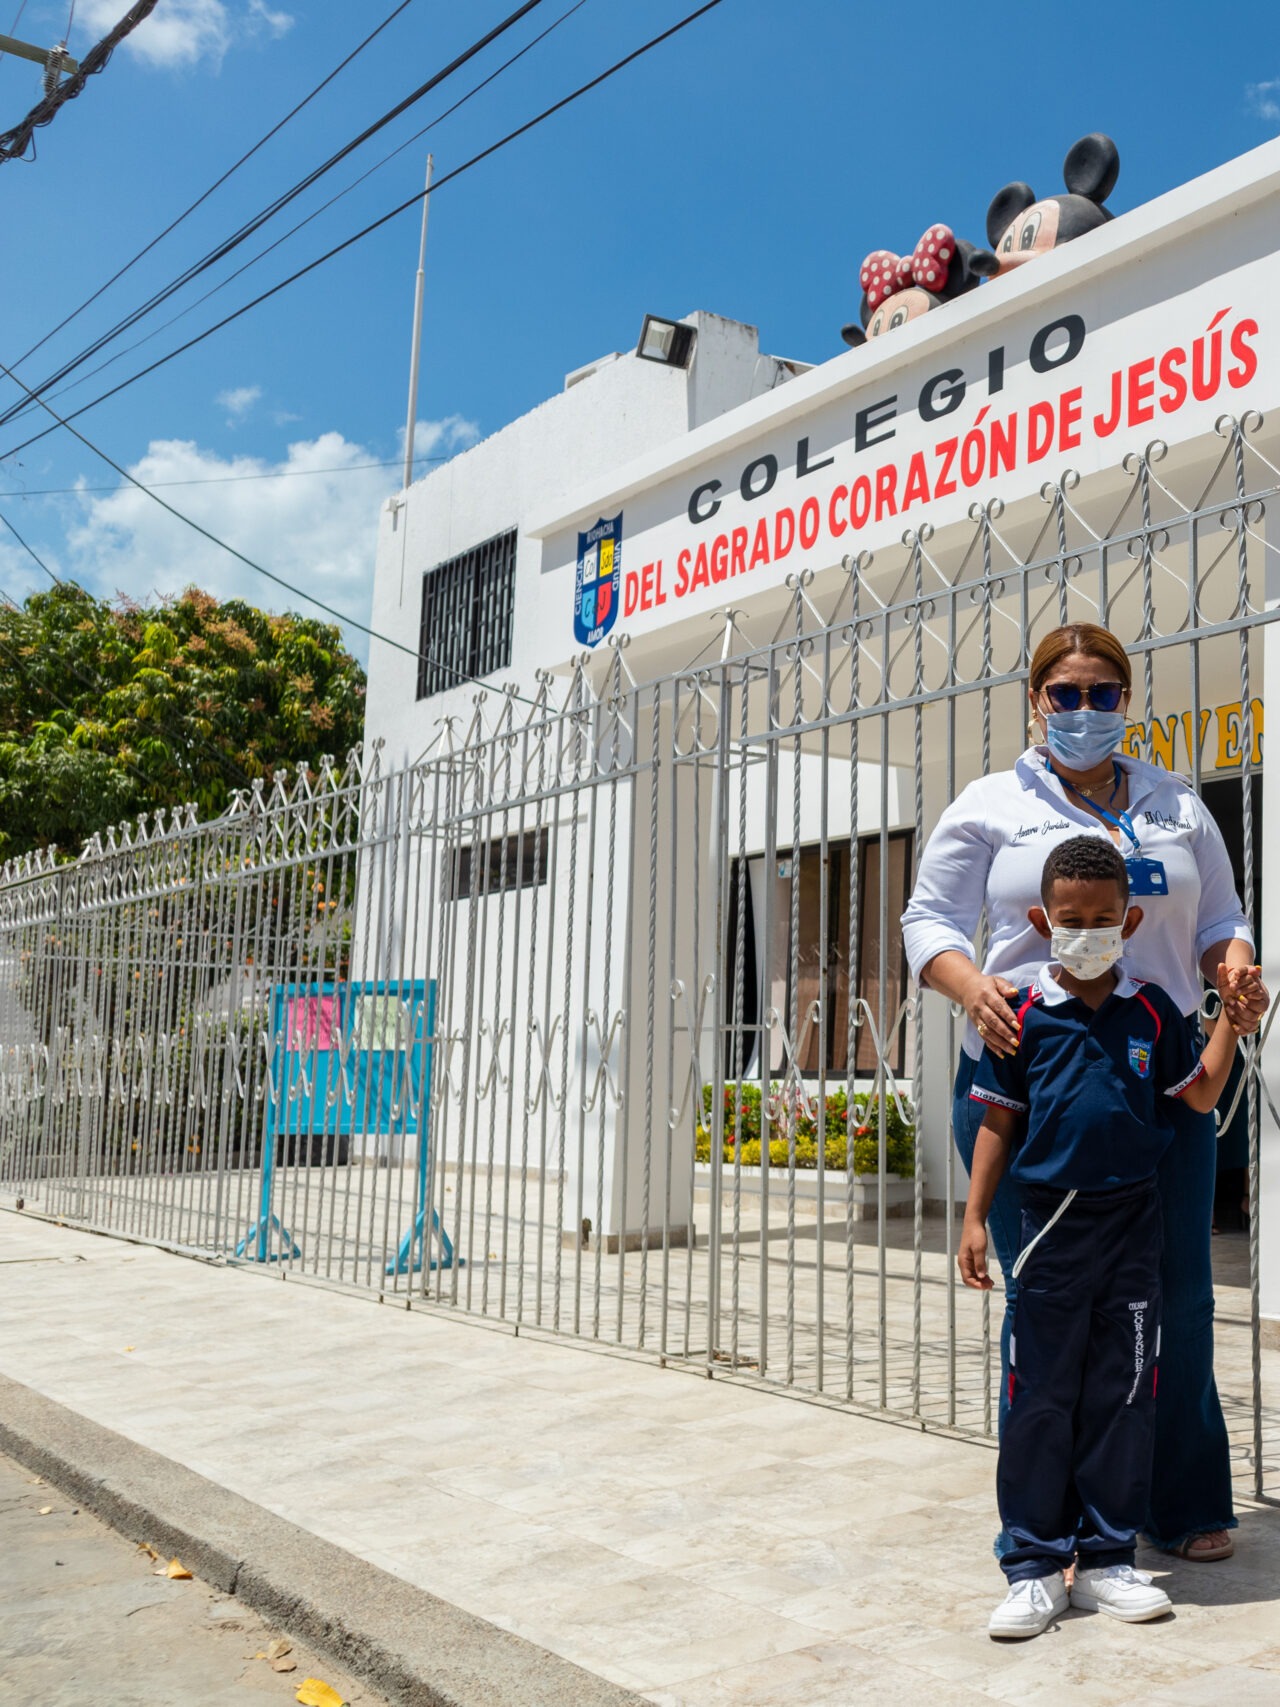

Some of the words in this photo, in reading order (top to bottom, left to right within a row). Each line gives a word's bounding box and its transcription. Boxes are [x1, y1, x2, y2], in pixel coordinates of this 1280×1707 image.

[688, 313, 1086, 525] COLEGIO
[624, 558, 667, 618] DEL
[674, 496, 820, 598] SAGRADO
[828, 404, 1018, 538] CORAZÓN
[1027, 386, 1082, 465] DE
[1093, 306, 1259, 439] JESÚS
[575, 559, 584, 616] CIENCIA
[613, 541, 622, 592] VIRTUD
[586, 626, 605, 645] AMOR
